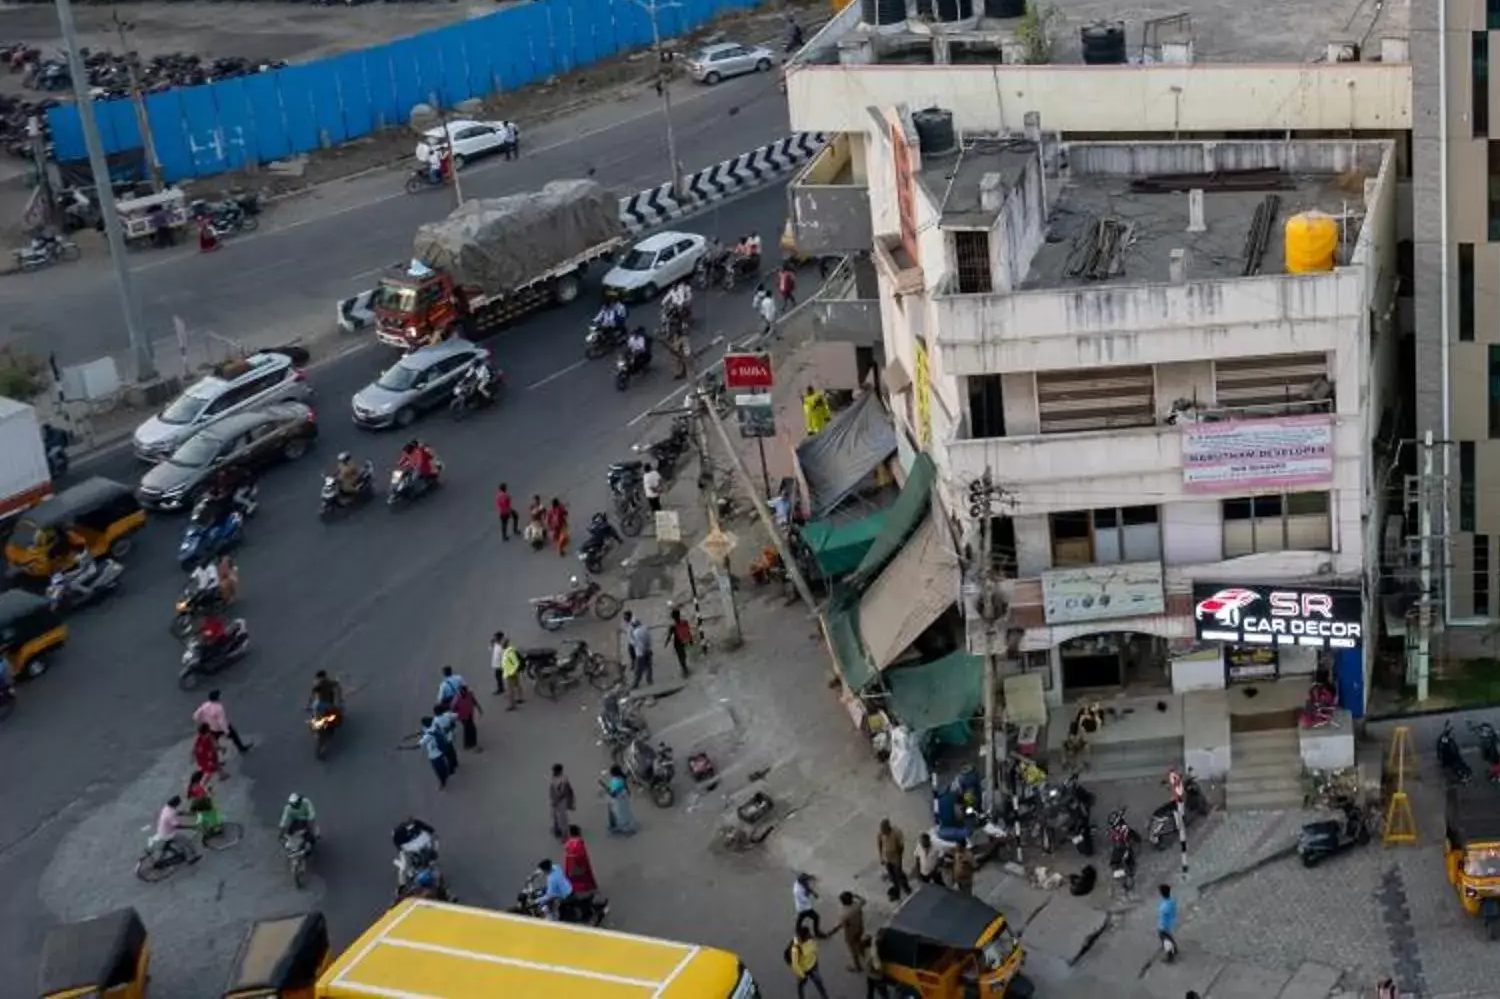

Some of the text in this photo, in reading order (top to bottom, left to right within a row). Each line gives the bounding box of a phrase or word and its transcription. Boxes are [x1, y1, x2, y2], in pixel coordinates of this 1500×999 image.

[1269, 591, 1333, 618] SR
[1243, 617, 1361, 638] CAR DECOR
